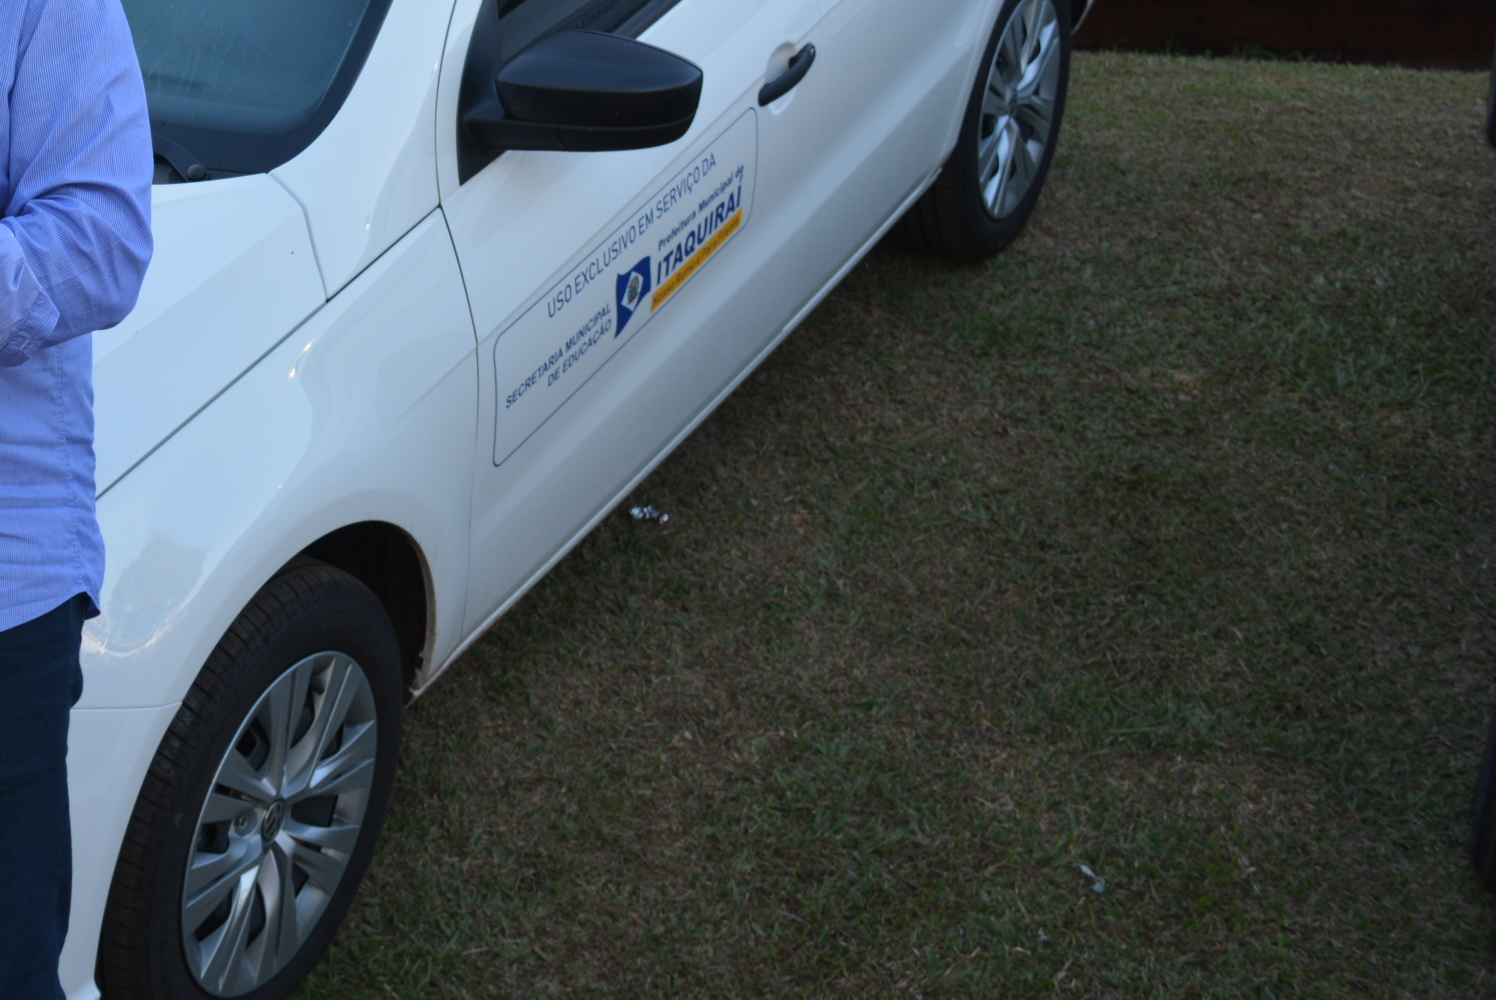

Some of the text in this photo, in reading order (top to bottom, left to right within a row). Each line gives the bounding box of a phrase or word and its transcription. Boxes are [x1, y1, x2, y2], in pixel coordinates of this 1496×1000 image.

[547, 152, 716, 318] USO EXCLUSIVO EM SERVIÇO DA
[656, 174, 744, 286] ITAQUIRAÍ
[658, 165, 744, 251] Prefeitura Municipal de
[506, 303, 611, 408] SECRETARIA MUNICIPAL
[547, 319, 611, 387] DE EDUCAÇÃO
